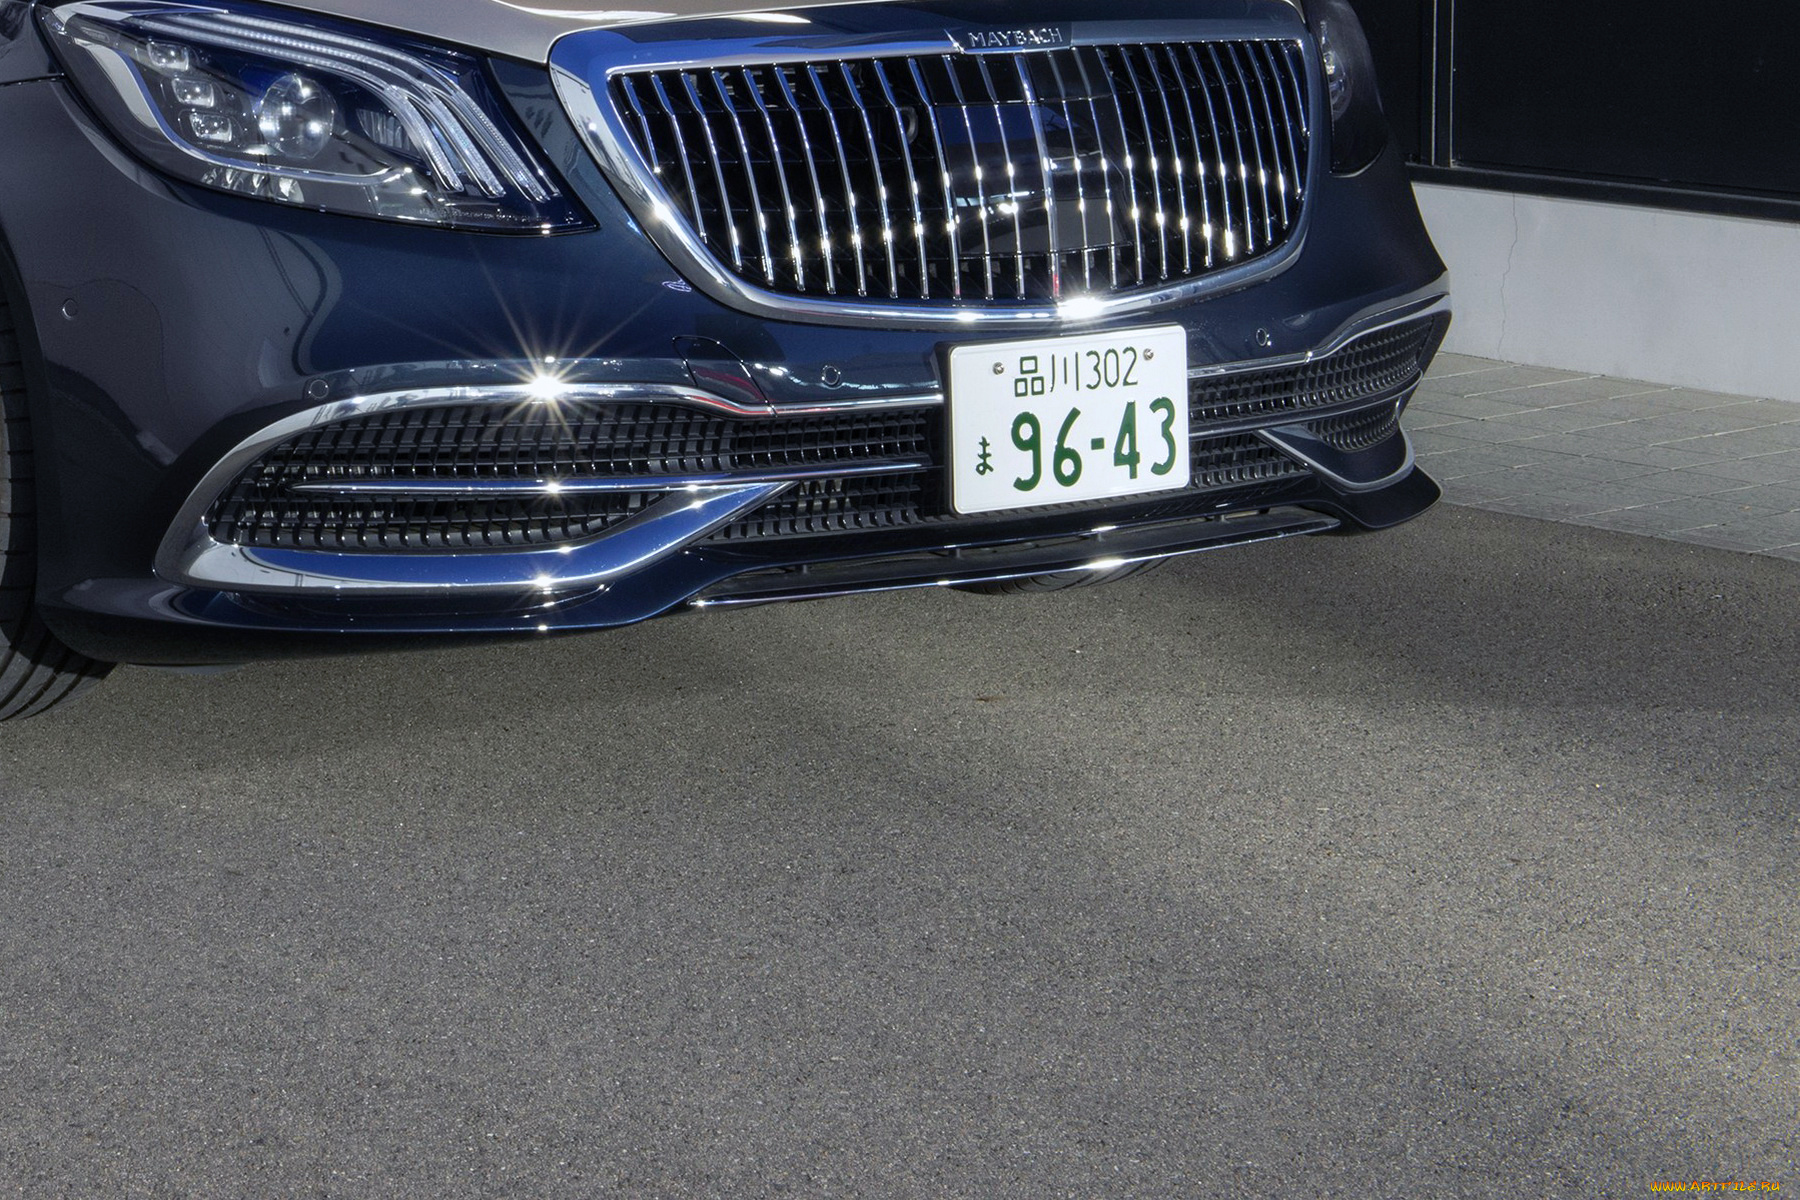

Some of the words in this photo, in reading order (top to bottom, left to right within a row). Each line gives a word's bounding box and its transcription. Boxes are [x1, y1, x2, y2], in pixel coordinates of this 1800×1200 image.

[968, 28, 1063, 47] MAYBACH
[975, 436, 994, 476] ま
[1011, 397, 1176, 492] 96-43
